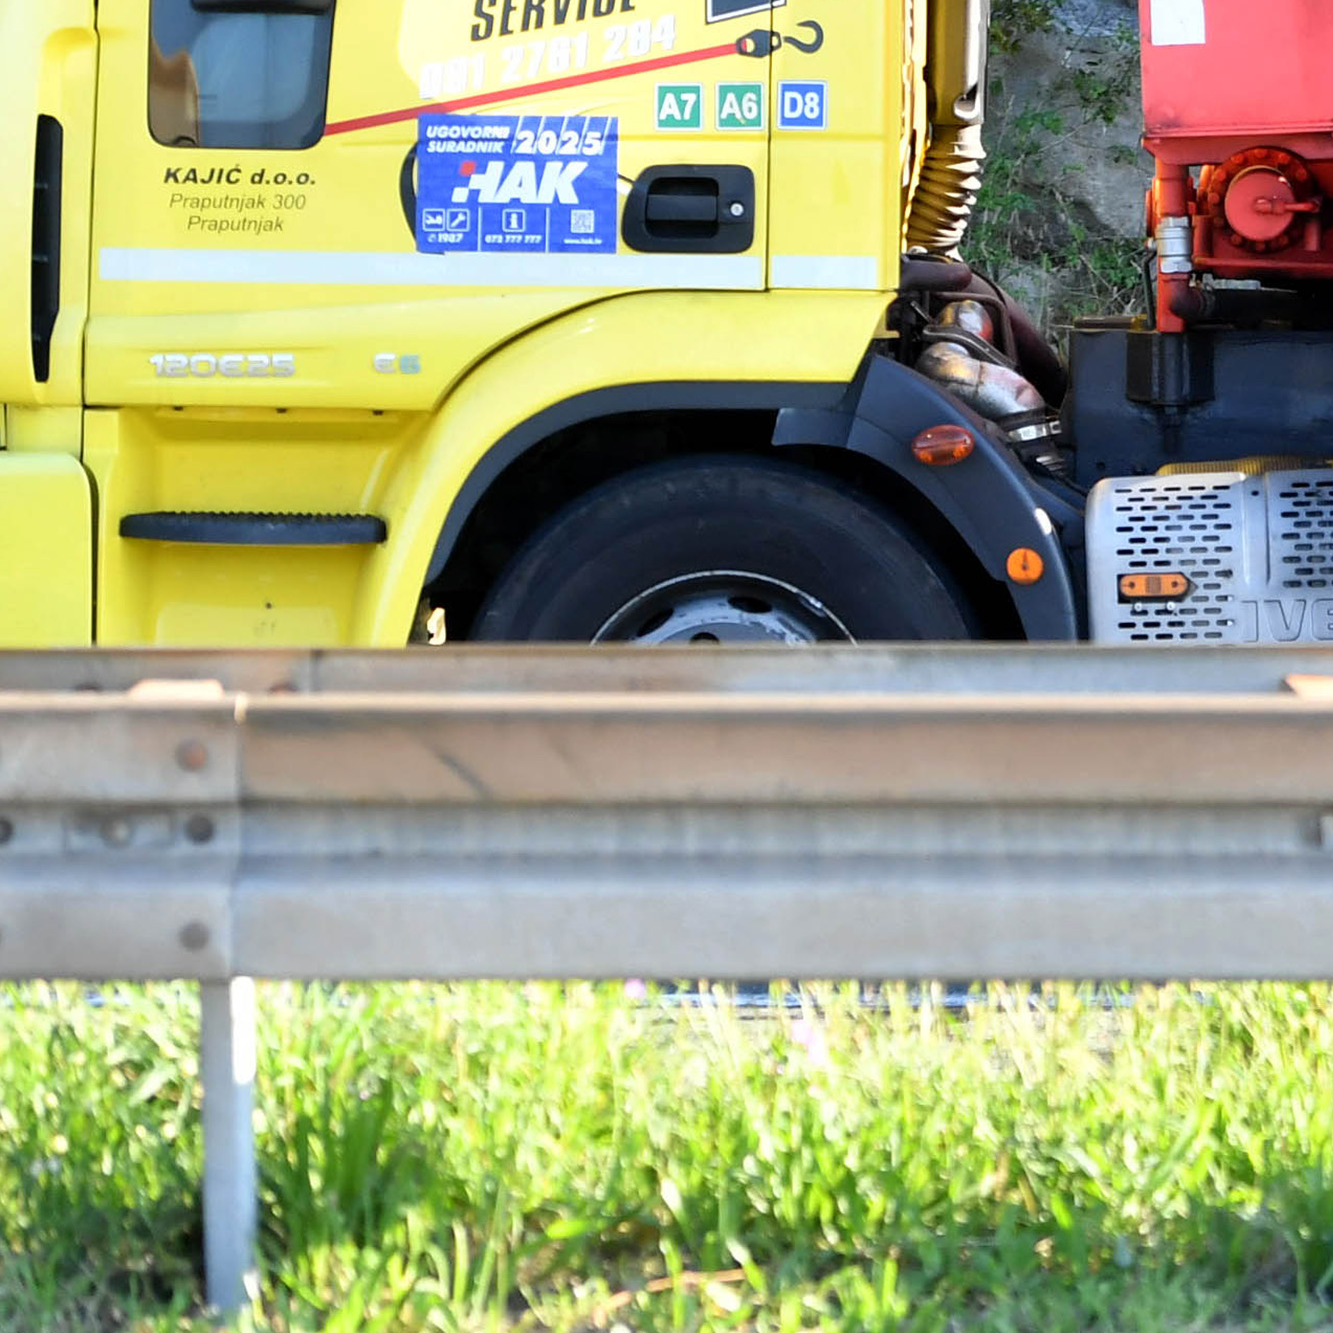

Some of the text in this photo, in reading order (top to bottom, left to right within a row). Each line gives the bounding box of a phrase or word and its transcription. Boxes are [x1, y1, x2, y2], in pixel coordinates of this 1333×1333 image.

[602, 14, 676, 62] 284
[659, 91, 820, 121] A7 A6 D8
[426, 125, 603, 156] UGOVORNI 2025
[426, 140, 505, 154] SURADNIK
[163, 163, 316, 185] KAJIĆ d.o.o.
[451, 160, 589, 205] HAK
[169, 193, 307, 214] Praputnjak 300
[187, 215, 284, 236] Praputnjak
[150, 353, 296, 378] 120E25
